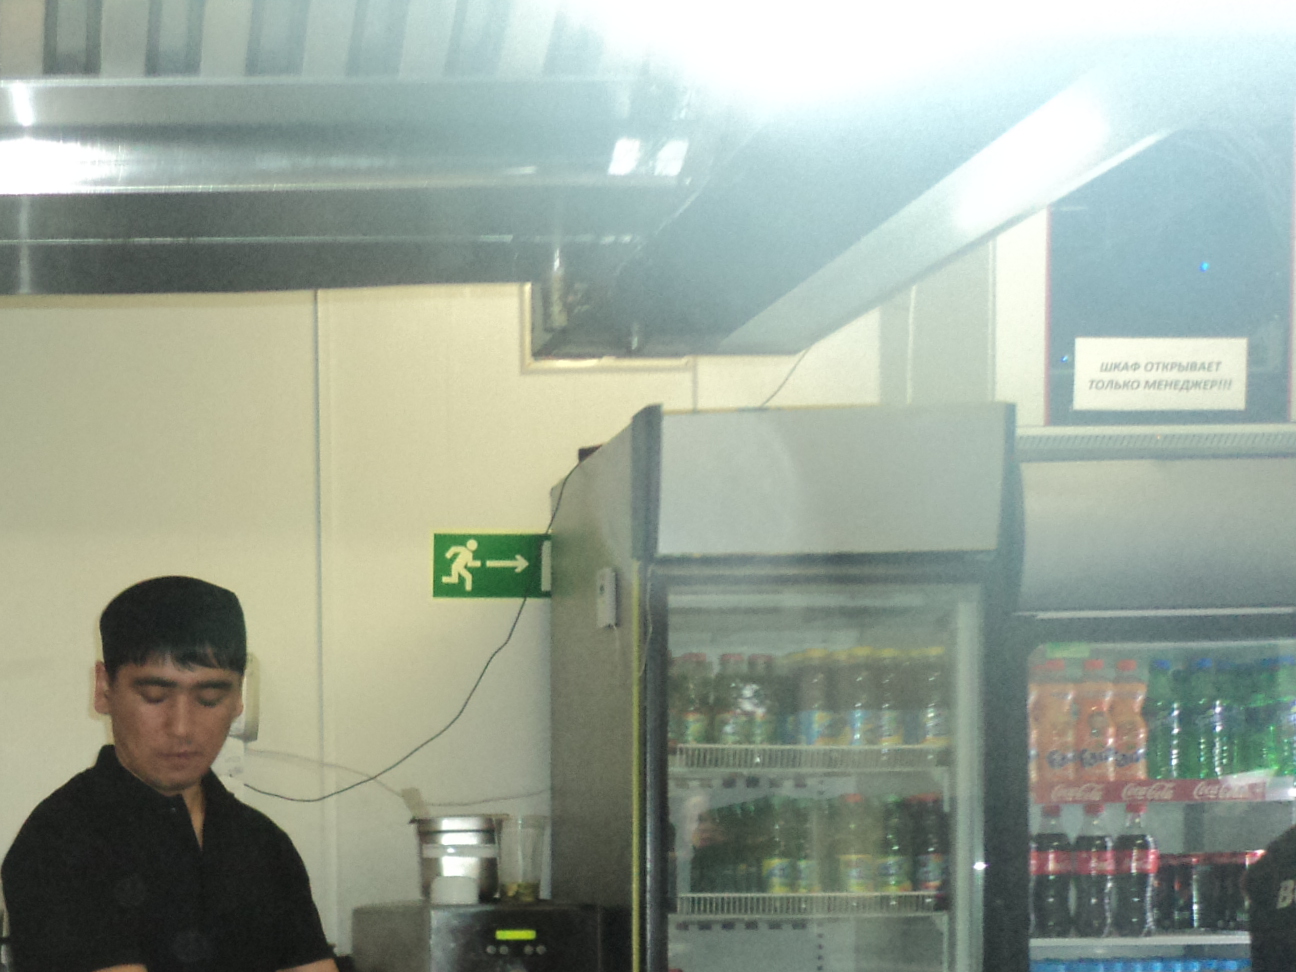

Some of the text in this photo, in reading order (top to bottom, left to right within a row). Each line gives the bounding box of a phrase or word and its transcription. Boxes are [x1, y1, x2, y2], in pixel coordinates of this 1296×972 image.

[1100, 361, 1222, 373] ШКАФ ОТКРЫВАЕТ
[1088, 379, 1140, 391] ТОЛЬКО
